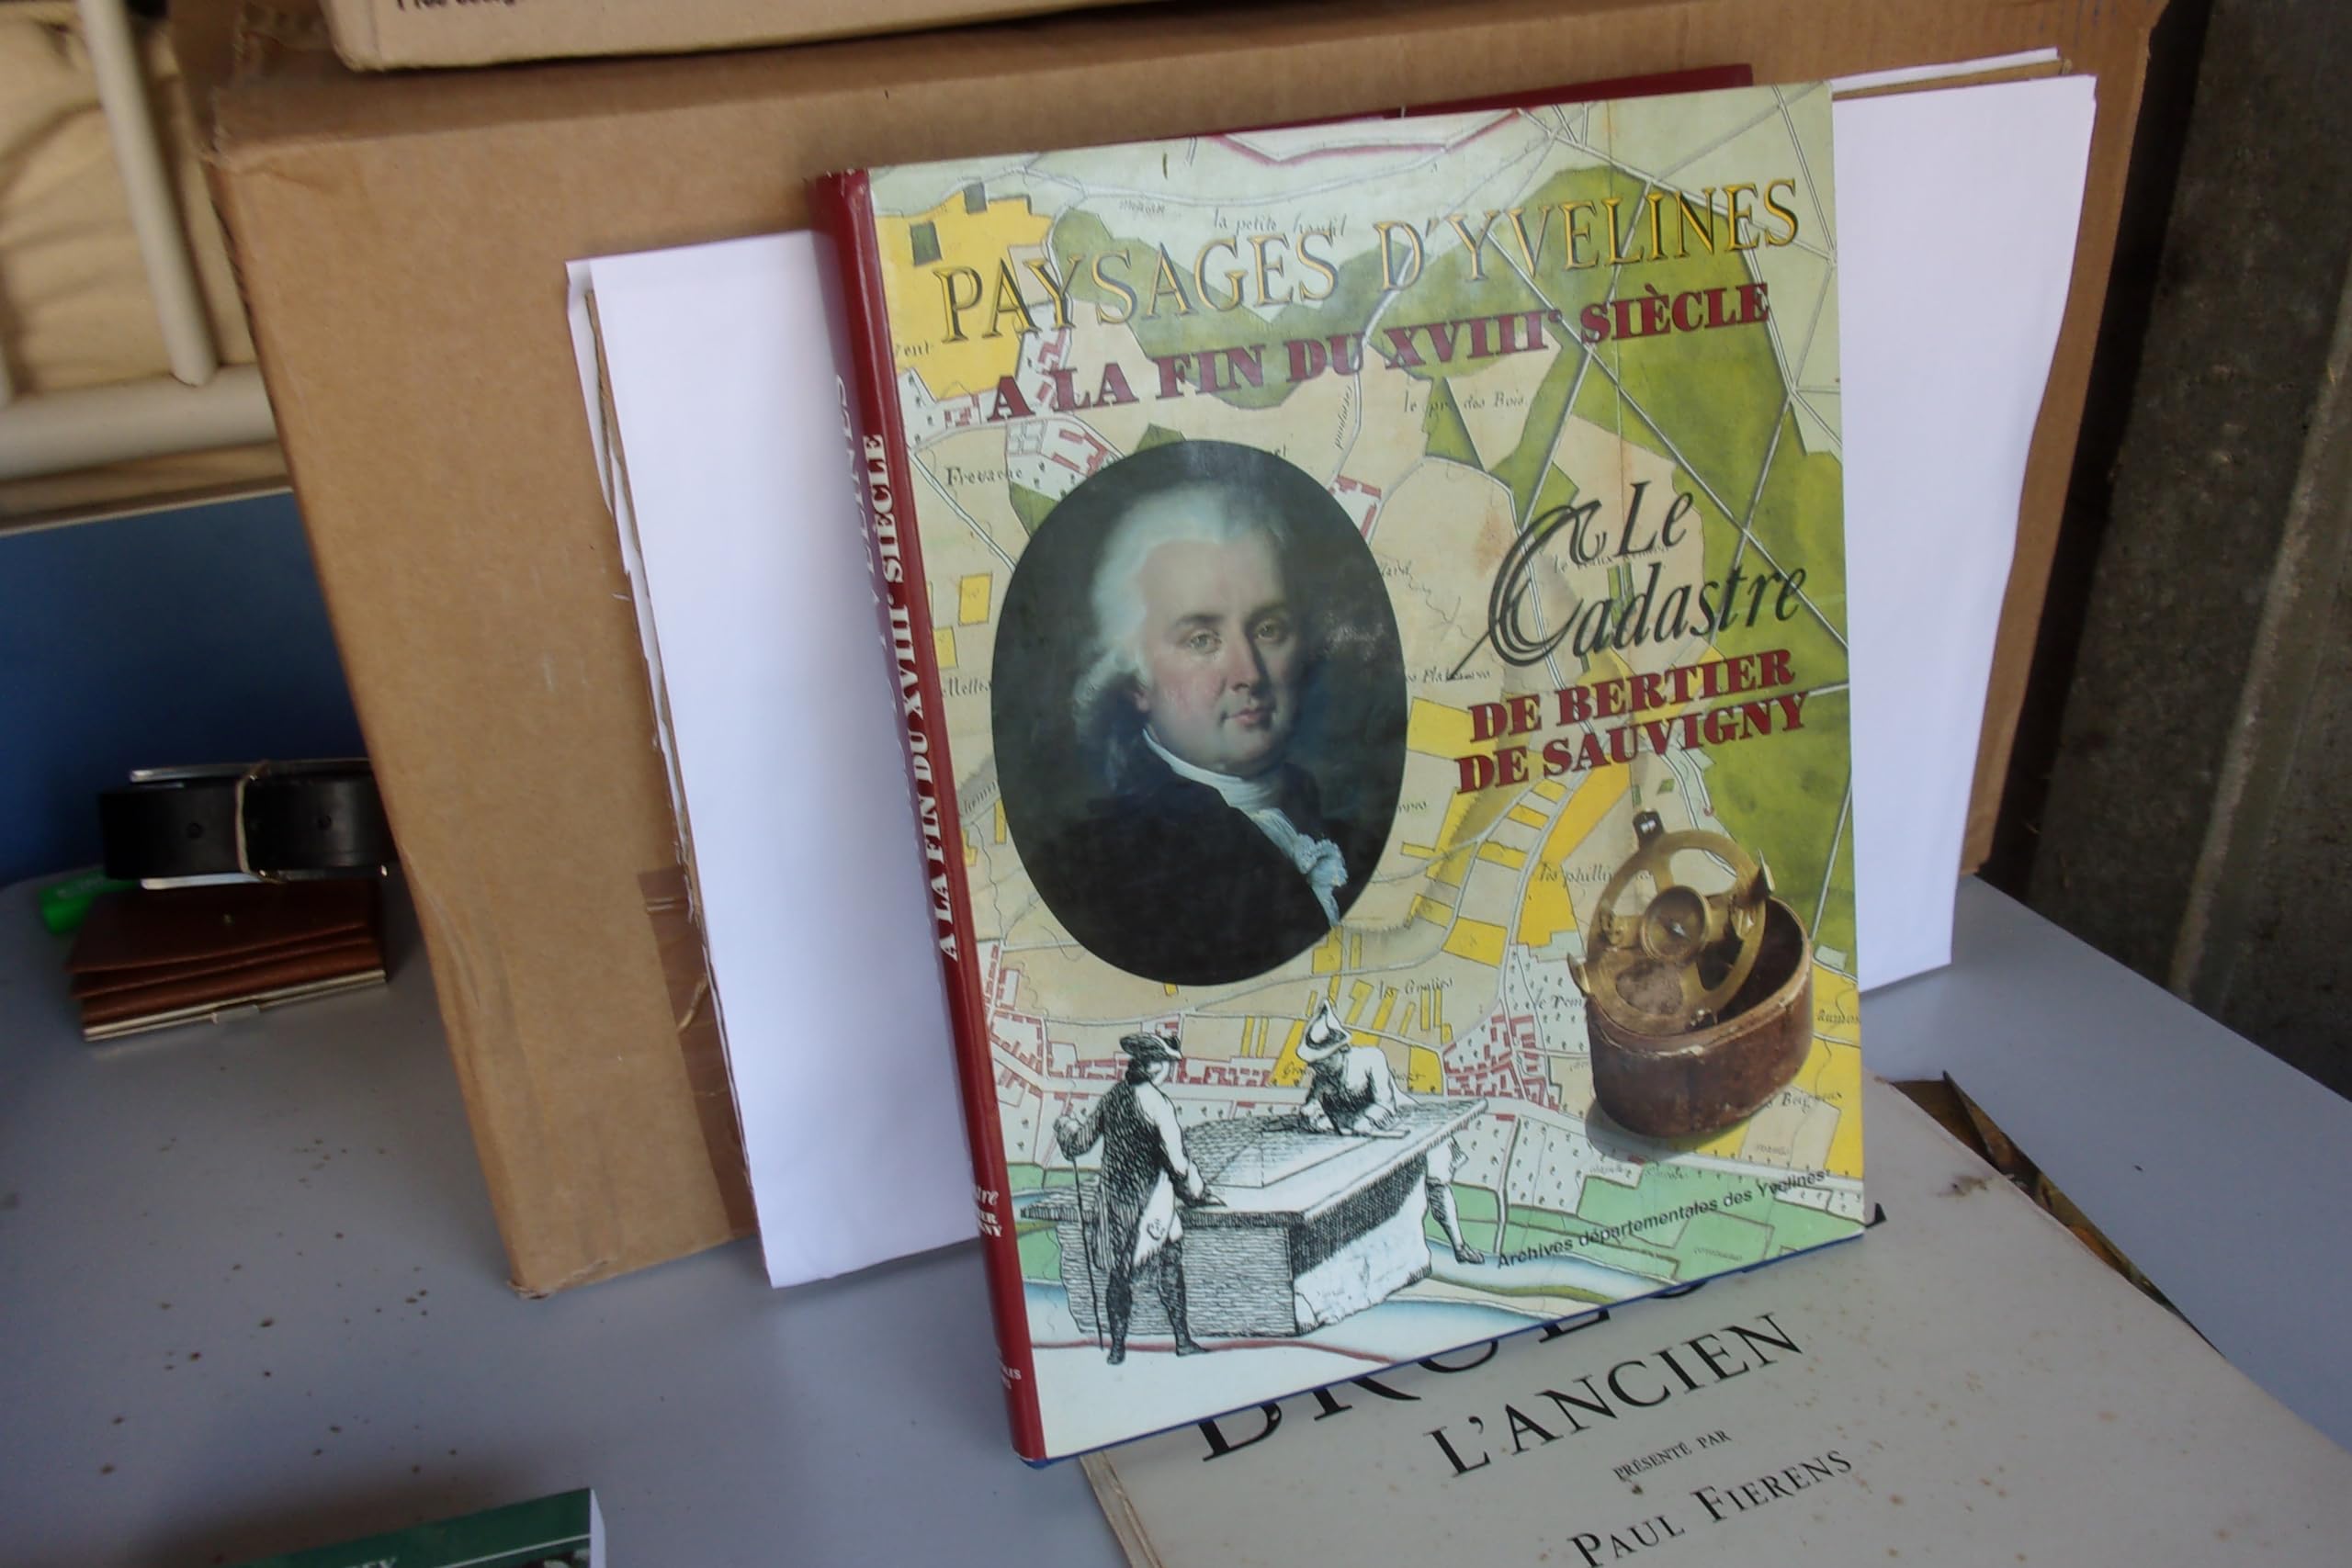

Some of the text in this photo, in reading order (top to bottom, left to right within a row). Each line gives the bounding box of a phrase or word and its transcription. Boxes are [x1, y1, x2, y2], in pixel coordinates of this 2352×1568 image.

[933, 177, 1800, 344] PAYSAGES D'YVELINES
[1051, 362, 1139, 413] LA
[1150, 344, 1266, 400] FIN
[1286, 330, 1366, 382] DU
[1580, 282, 1770, 345] SIÈCLE
[1614, 480, 1694, 558] Le
[1446, 499, 1808, 681] Cadastre
[1455, 692, 1810, 794] DE SAUVIGNY
[1468, 649, 1796, 742] DE BERTIER
[908, 728, 934, 784] DU
[918, 796, 945, 866] FIN
[931, 873, 954, 925] LA
[1498, 1170, 1826, 1269] Archives départementales des Yvelines
[1423, 1313, 1804, 1477] L'ANCIEN
[1612, 1430, 1733, 1481] PRÉSENTÉ PAR
